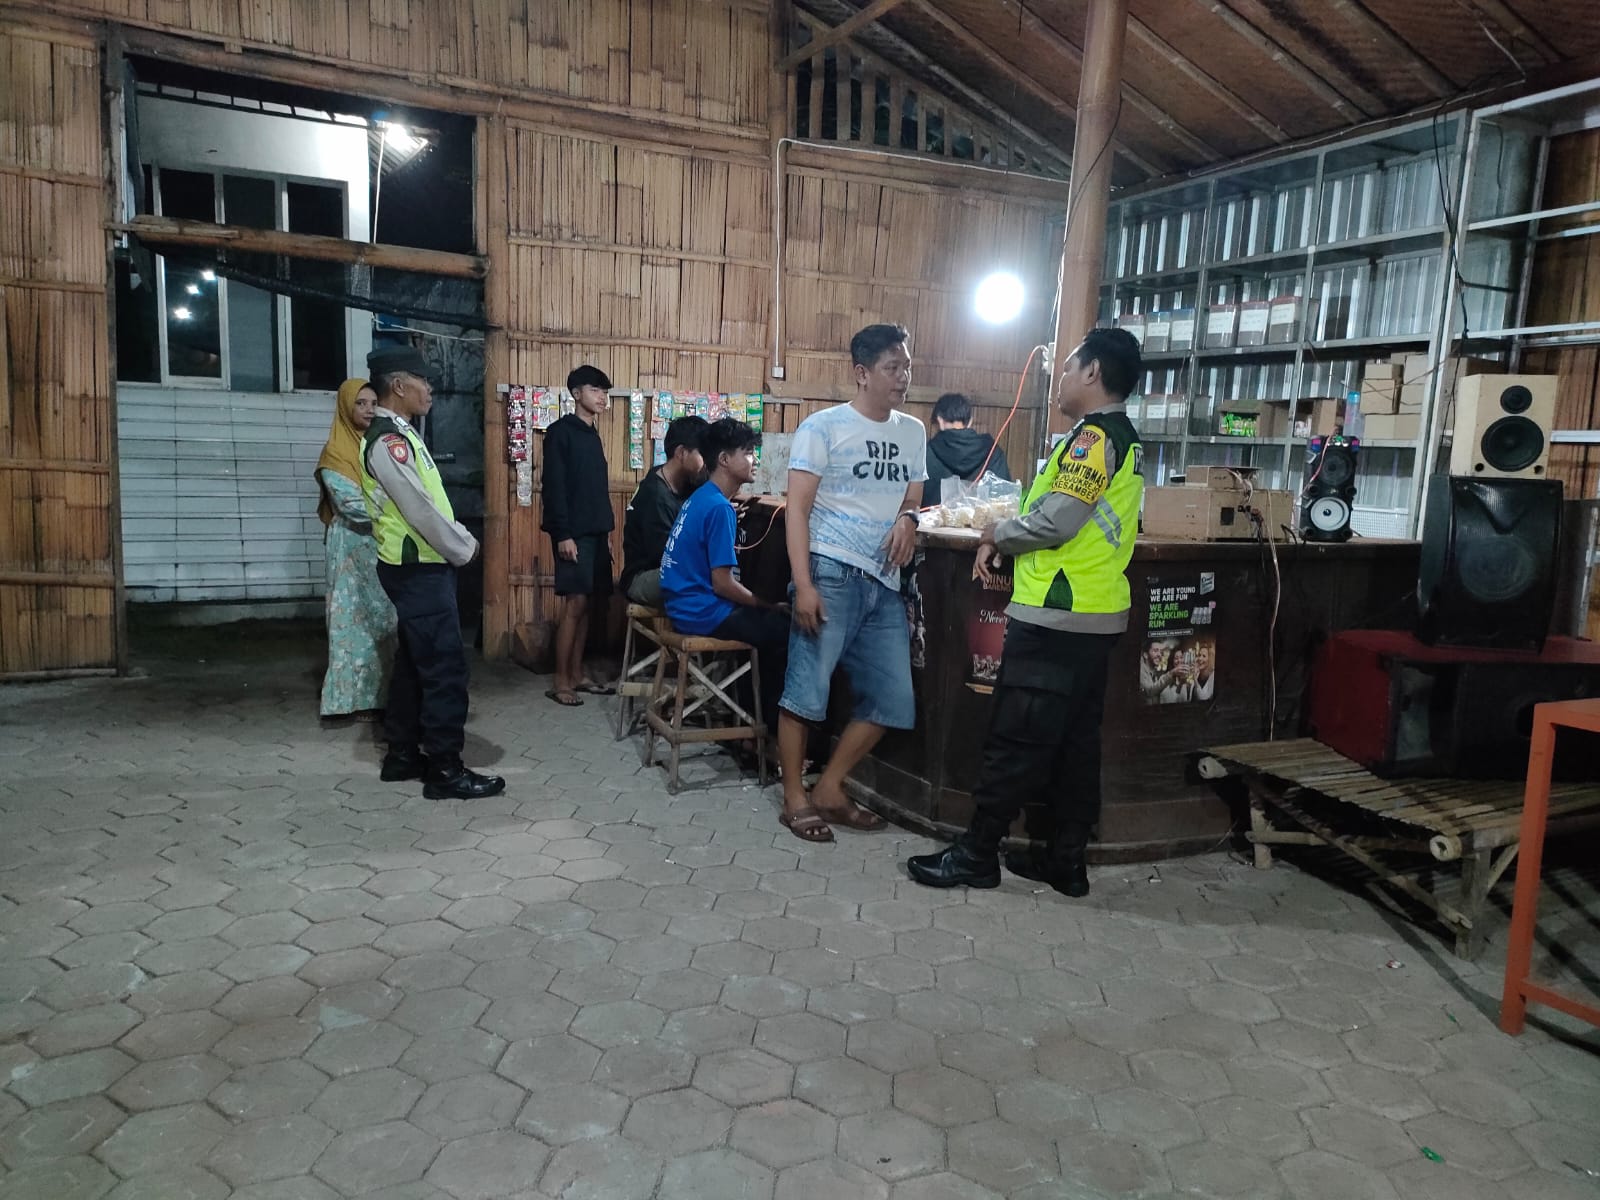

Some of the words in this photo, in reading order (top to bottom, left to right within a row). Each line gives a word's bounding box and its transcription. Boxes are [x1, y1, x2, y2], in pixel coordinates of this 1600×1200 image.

[866, 440, 899, 460] RIP
[1162, 587, 1175, 595] ARE
[1176, 586, 1196, 594] YOUNG
[1150, 603, 1162, 611] WE
[1164, 602, 1179, 611] ARE
[1149, 610, 1189, 620] SPARKLING
[1148, 620, 1165, 628] RUM
